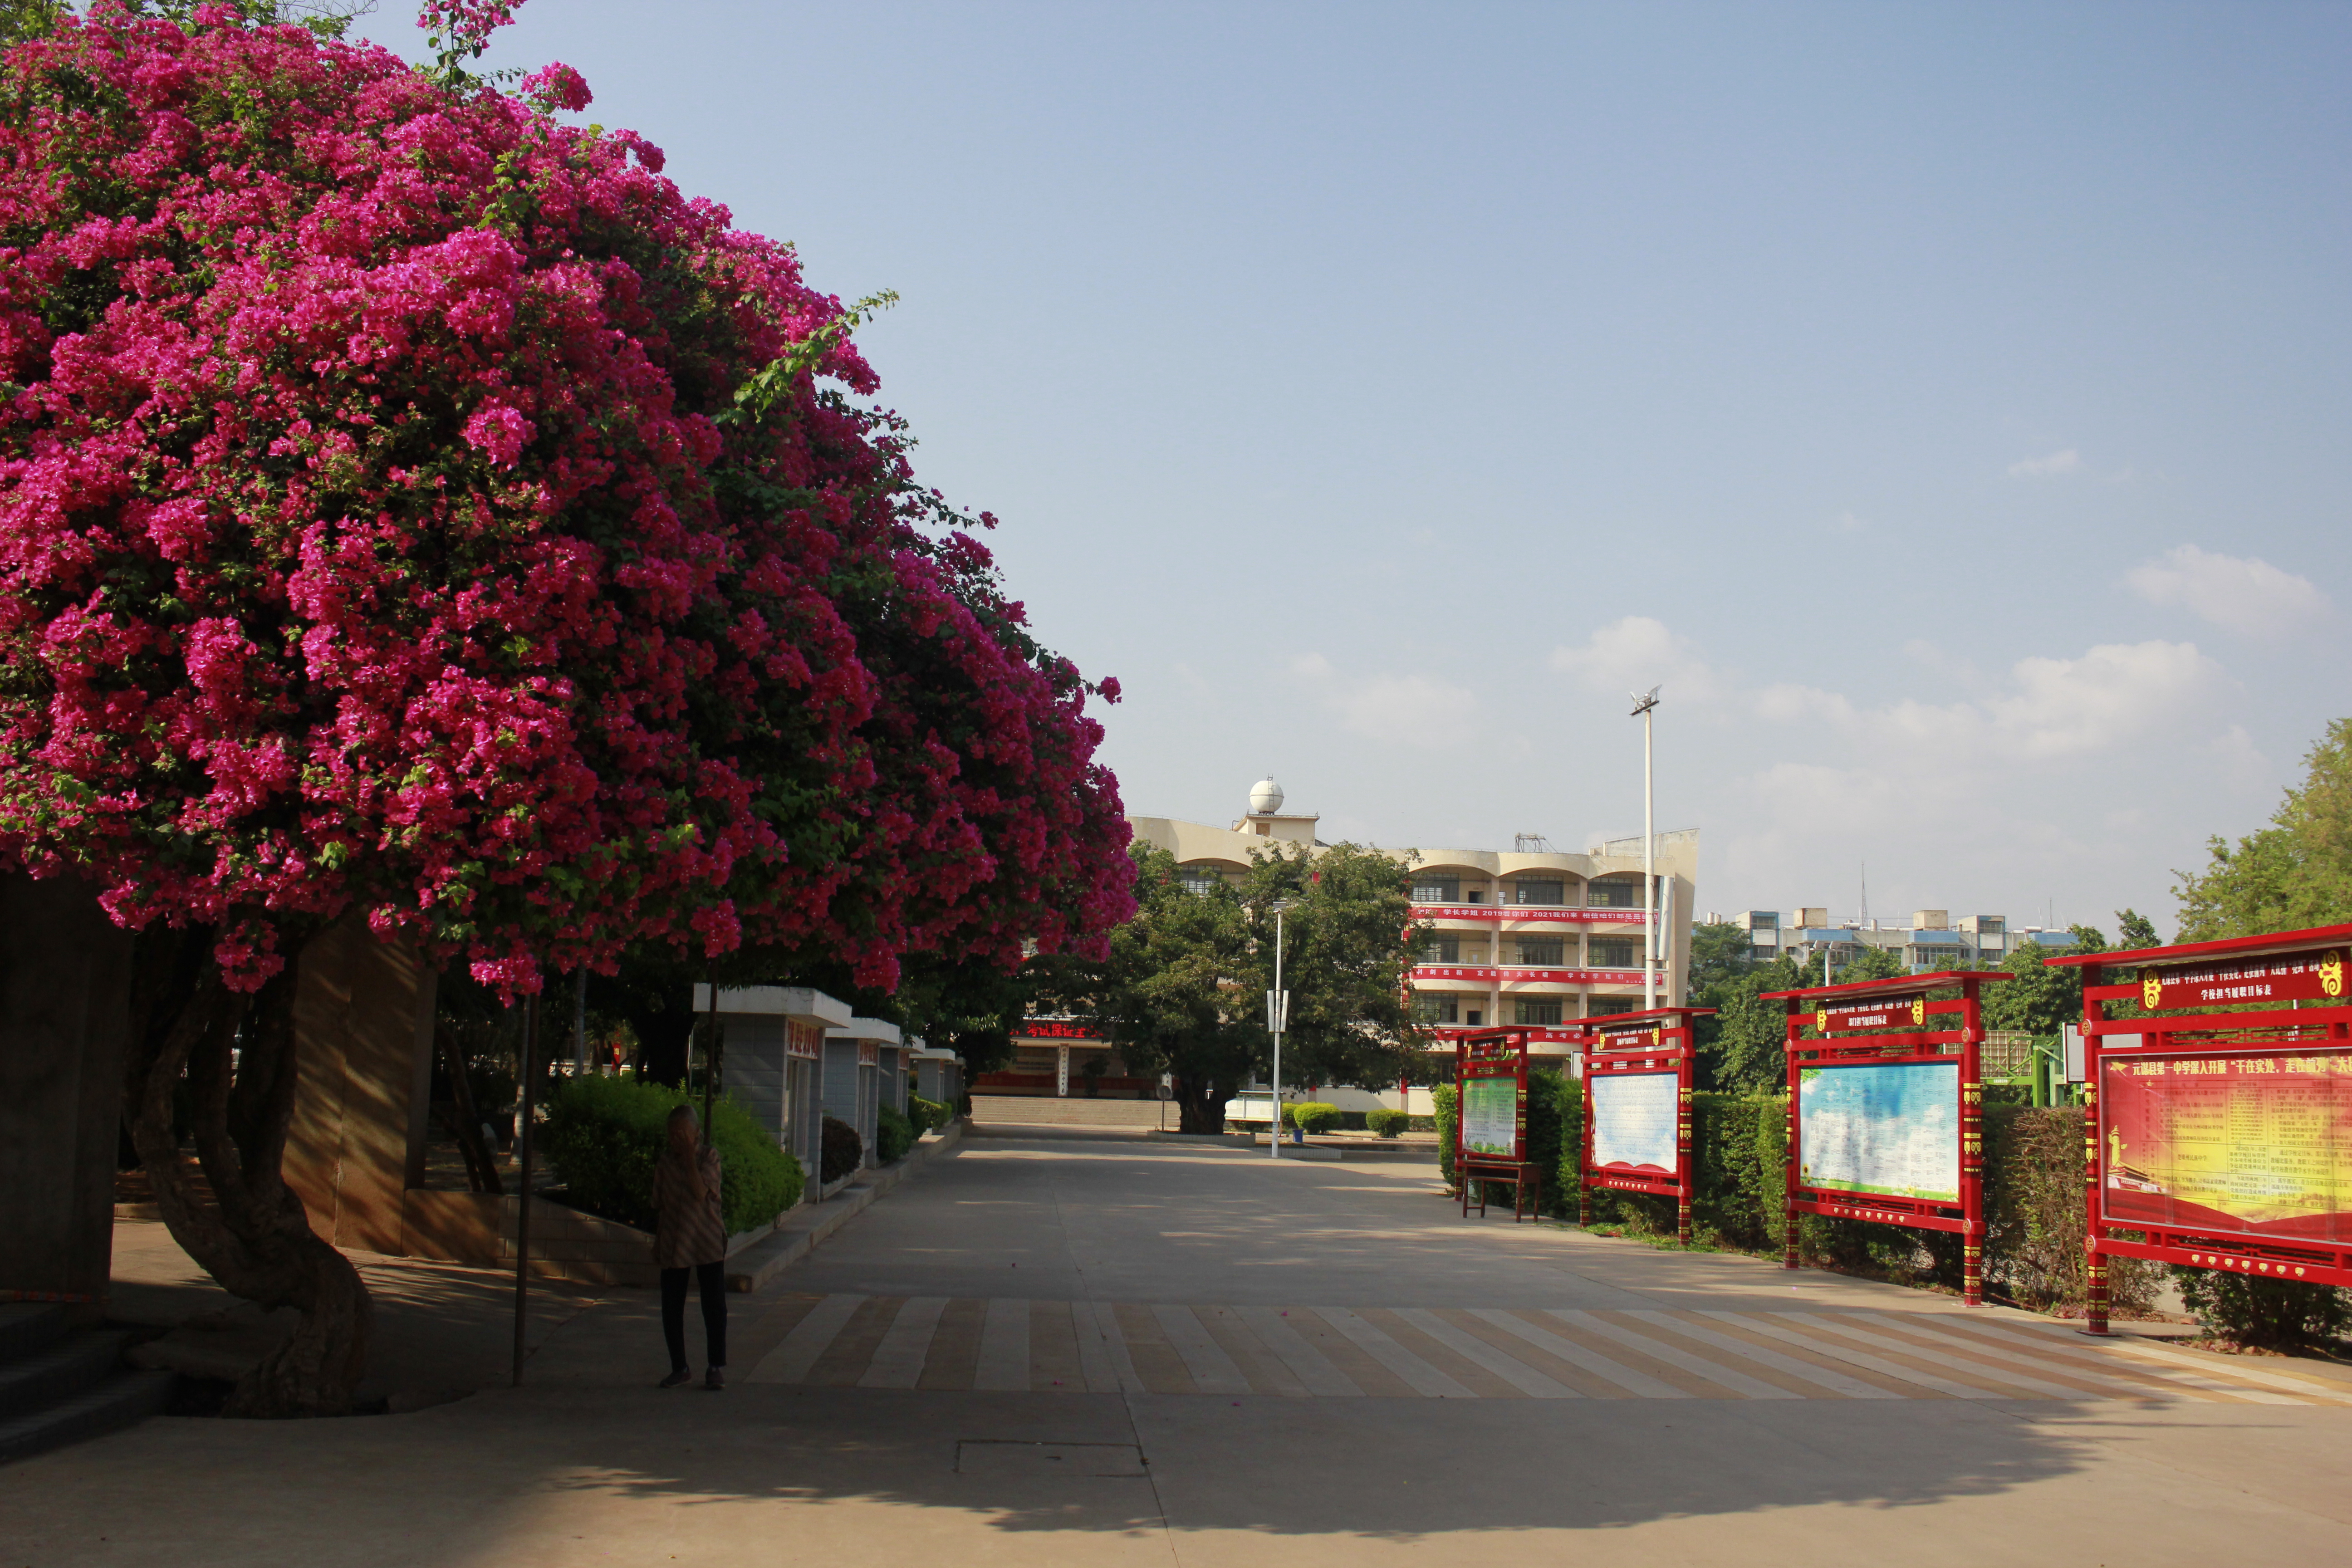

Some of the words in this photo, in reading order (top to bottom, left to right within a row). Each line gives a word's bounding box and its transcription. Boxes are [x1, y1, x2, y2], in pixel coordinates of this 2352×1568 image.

[2200, 984, 2271, 1000] 学校担当履职目标表
